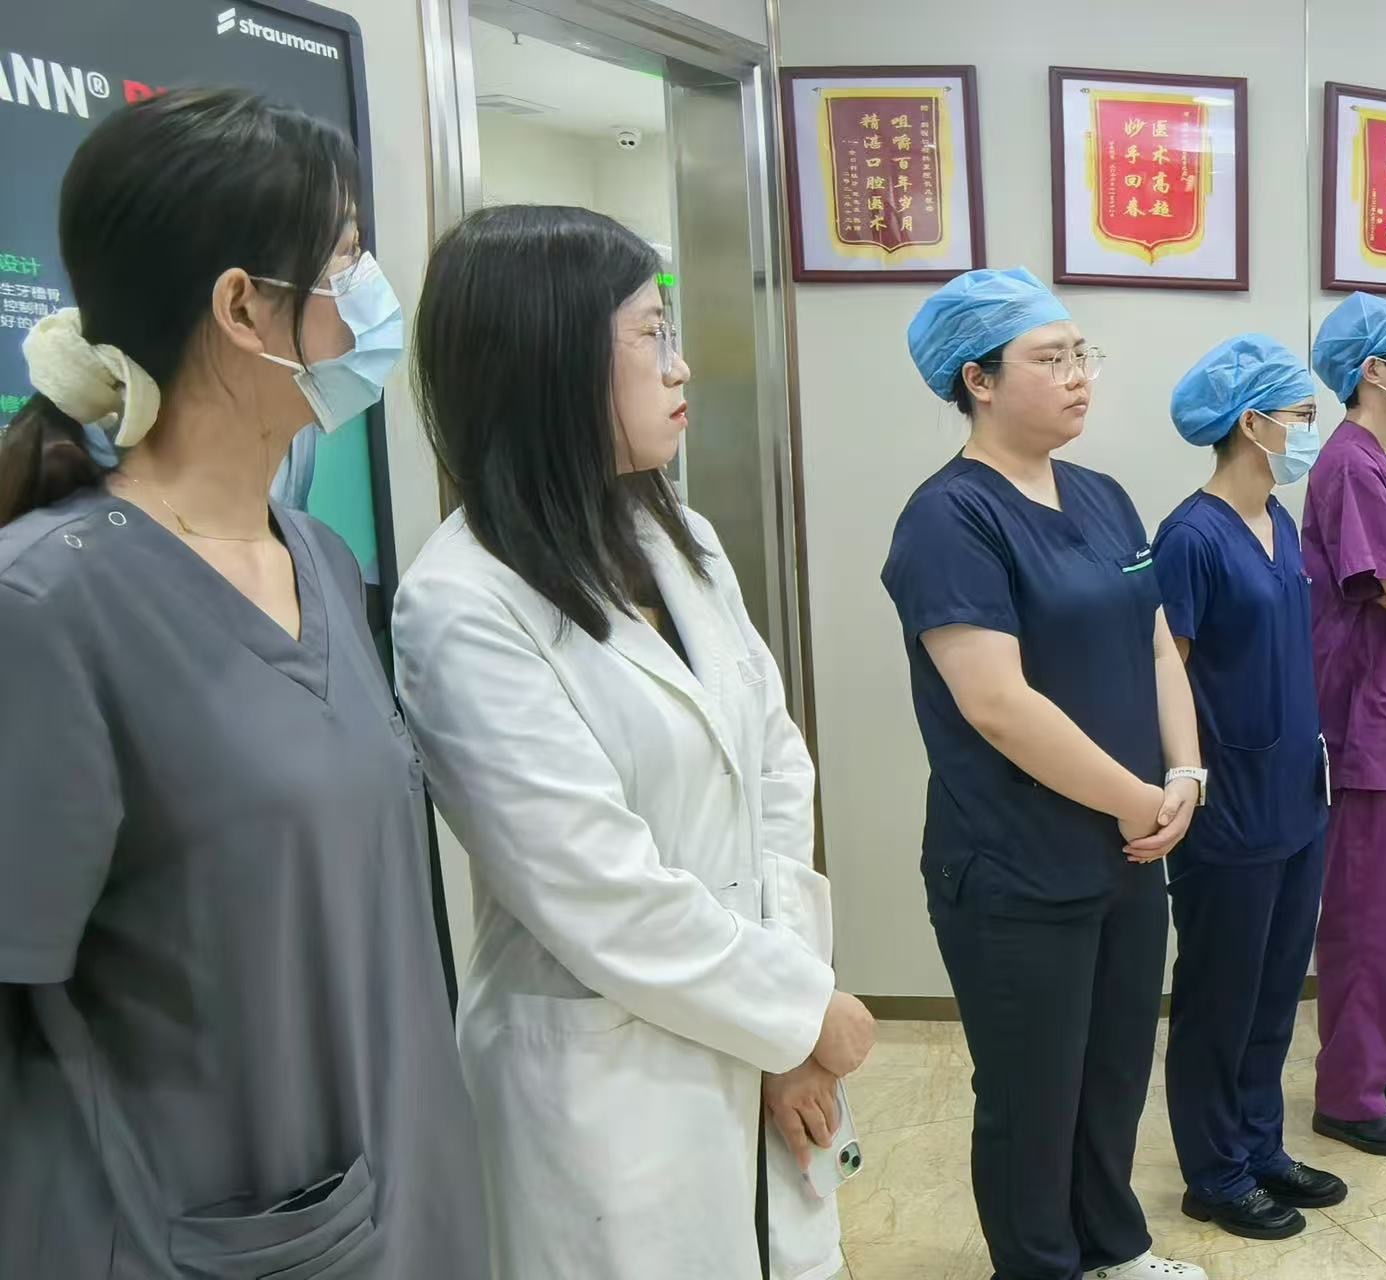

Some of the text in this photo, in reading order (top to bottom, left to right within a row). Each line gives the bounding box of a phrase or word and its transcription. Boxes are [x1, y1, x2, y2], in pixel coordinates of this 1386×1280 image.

[239, 19, 338, 60] straumann
[1123, 118, 1148, 217] 妙手回春
